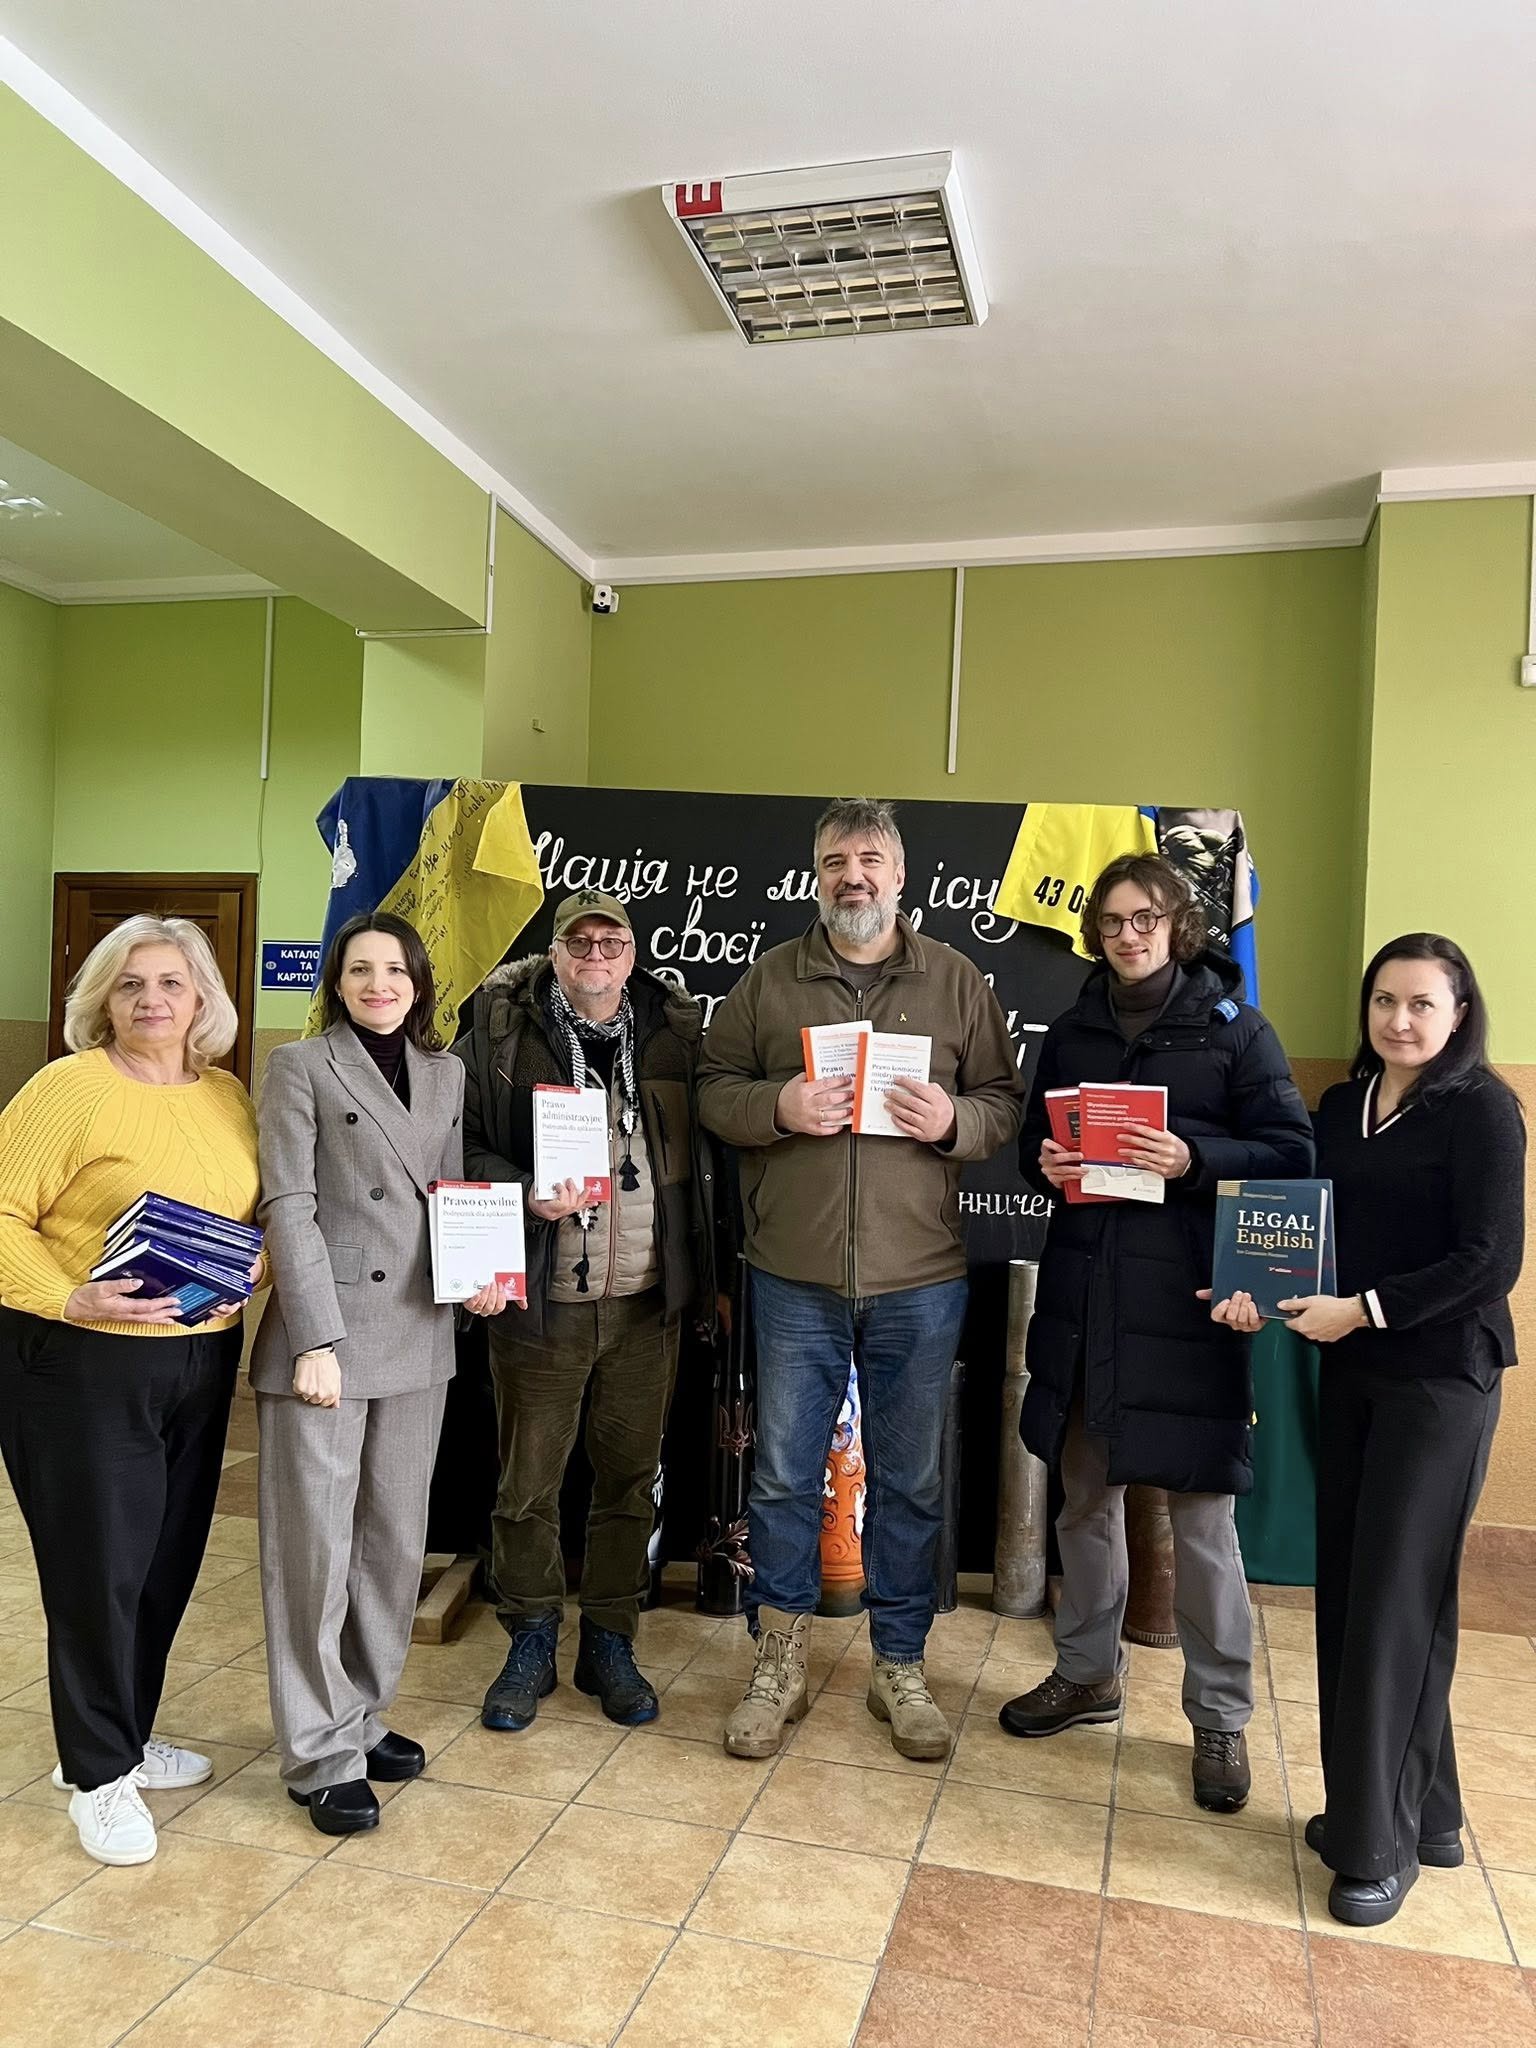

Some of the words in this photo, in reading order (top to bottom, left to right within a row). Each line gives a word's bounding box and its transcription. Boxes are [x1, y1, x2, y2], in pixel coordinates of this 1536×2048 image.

[533, 831, 670, 904] Нація
[685, 864, 739, 897] не
[1033, 875, 1066, 907] 43
[1067, 884, 1090, 914] 0
[650, 895, 767, 966] своєї
[280, 949, 320, 959] КАТАЛО
[300, 961, 313, 971] ТА
[277, 972, 316, 982] КАРТОТ
[541, 1098, 566, 1109] Prawo
[541, 1110, 603, 1125] administracyjne
[443, 1195, 476, 1206] Prawo
[478, 1196, 518, 1209] cywilne
[1237, 1209, 1316, 1231] LEGAL
[1236, 1228, 1315, 1249] English
